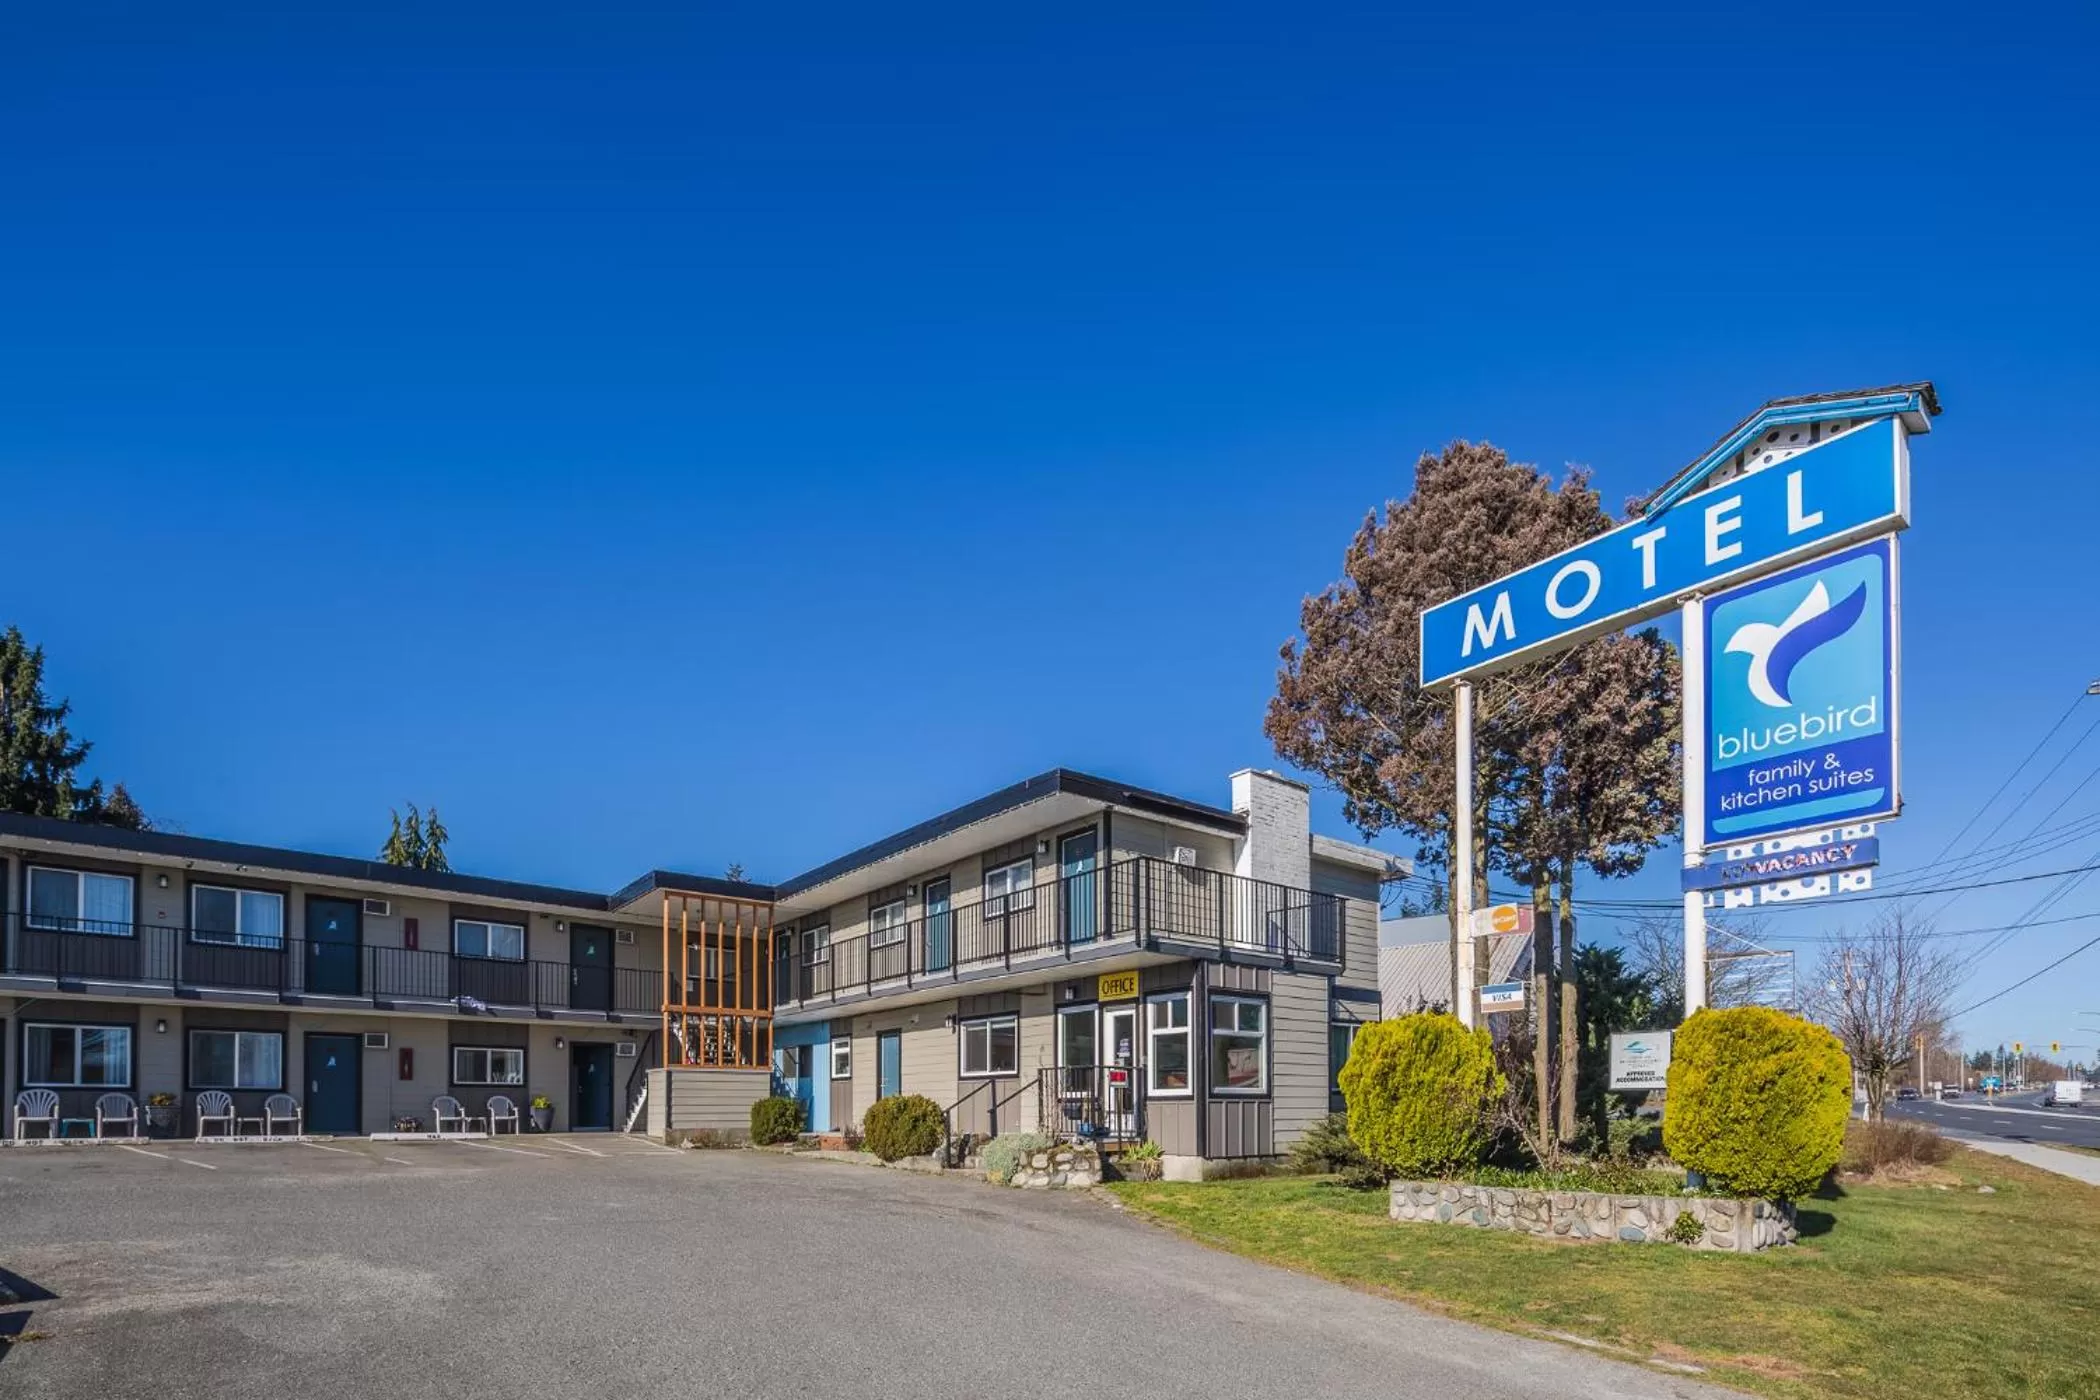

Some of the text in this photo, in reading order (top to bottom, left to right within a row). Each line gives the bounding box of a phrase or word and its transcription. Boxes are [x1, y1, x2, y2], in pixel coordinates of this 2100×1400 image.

[1461, 470, 1823, 656] MOTEL
[1718, 695, 1876, 759] bluebird
[1748, 752, 1840, 786] family &
[1721, 768, 1874, 811] kitchen suites
[1755, 845, 1857, 874] VACANCY
[1102, 977, 1134, 994] OFFICE
